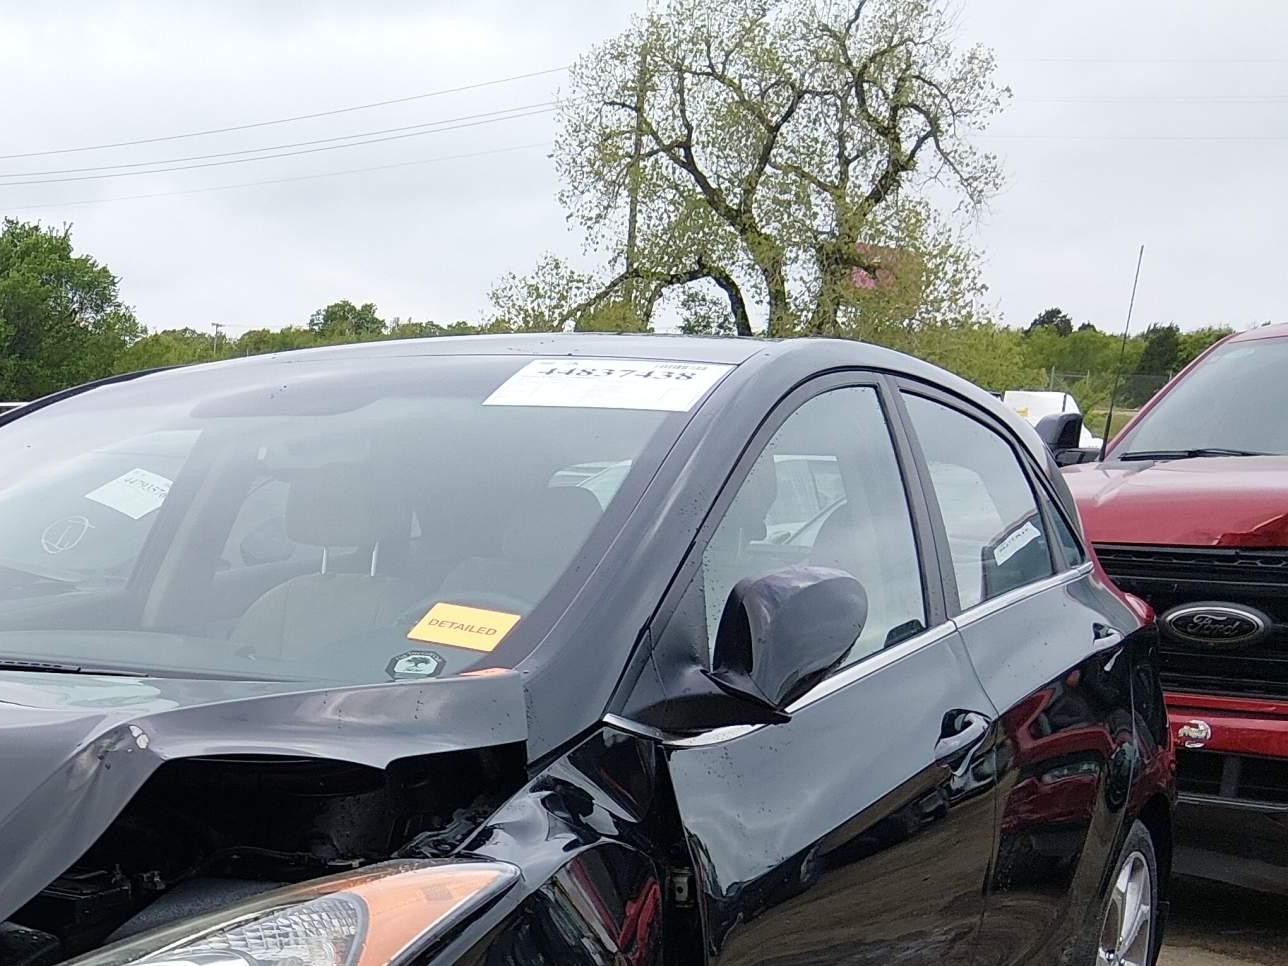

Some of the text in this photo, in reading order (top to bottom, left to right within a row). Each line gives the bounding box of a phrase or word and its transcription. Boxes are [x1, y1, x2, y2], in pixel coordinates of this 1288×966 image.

[538, 367, 696, 380] 44837438
[428, 618, 497, 636] DETAILED
[1187, 614, 1241, 635] Ford
